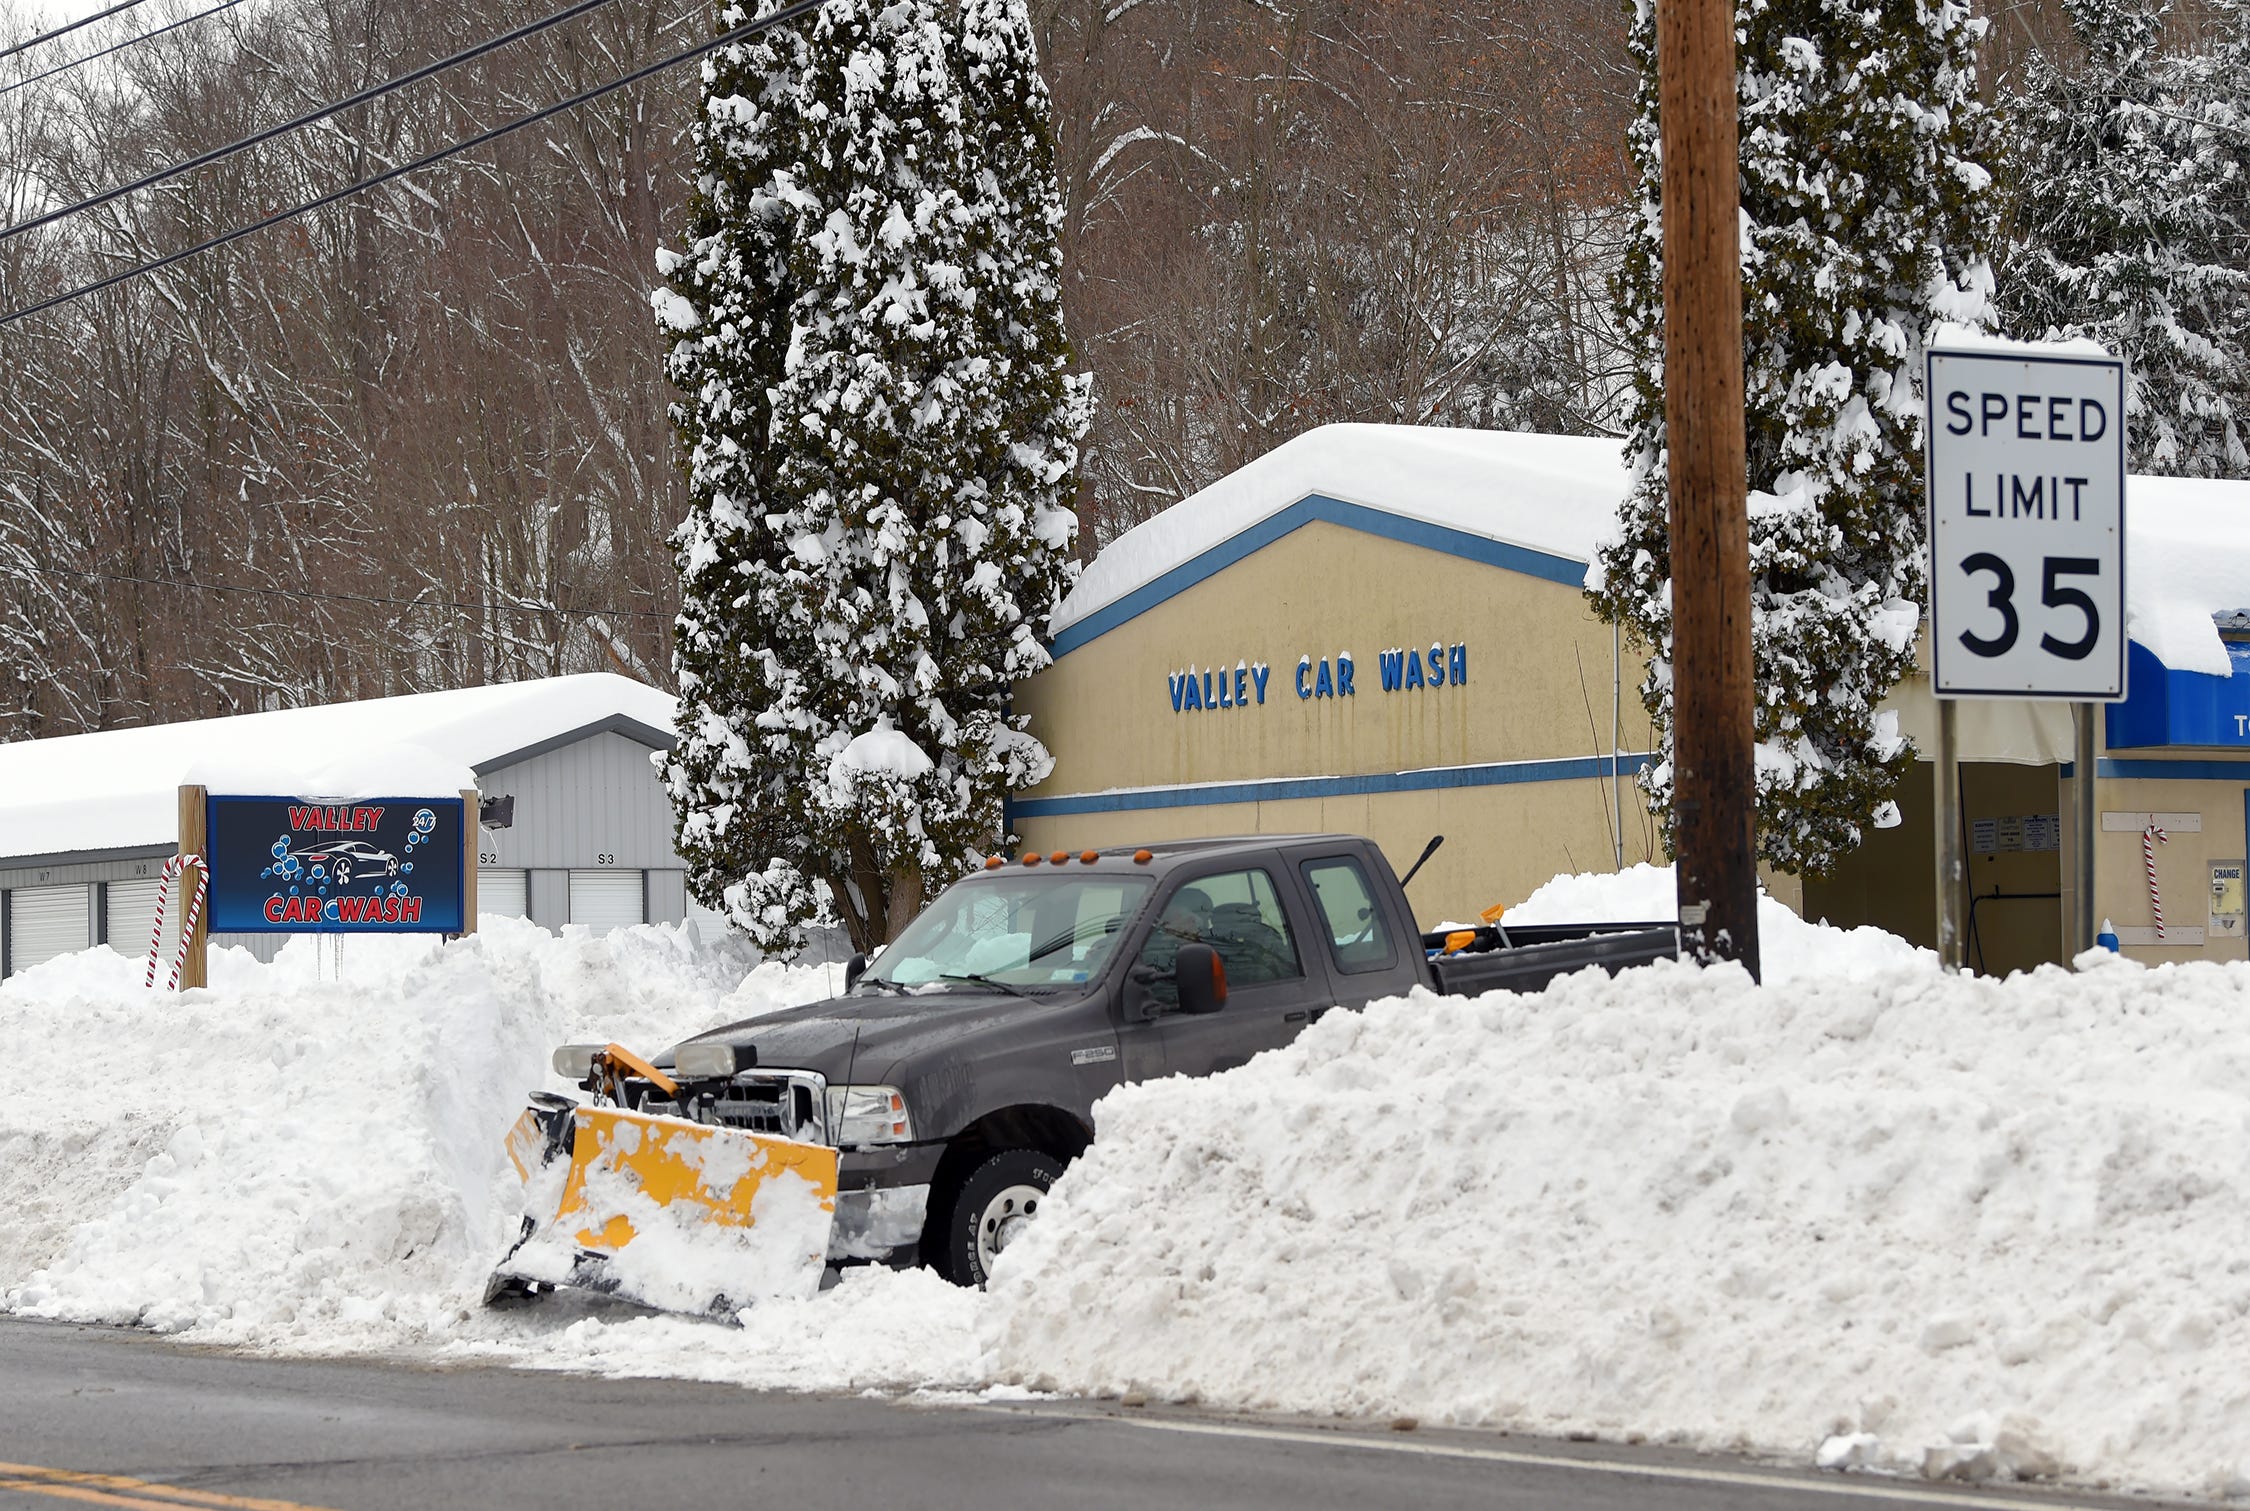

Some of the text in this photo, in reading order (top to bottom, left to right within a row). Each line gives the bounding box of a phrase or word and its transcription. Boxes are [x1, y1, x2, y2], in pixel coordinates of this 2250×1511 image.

[1946, 390, 2106, 442] SPEED
[1965, 472, 2088, 521] LIMIT
[1958, 552, 2100, 660] 35
[1168, 646, 1466, 712] VALLEY CAR WASH
[2234, 715, 2250, 737] T
[288, 806, 385, 831] VALLEY
[412, 816, 436, 828] 24/7
[2213, 869, 2240, 879] CHANGE
[264, 896, 423, 923] CAR WASH
